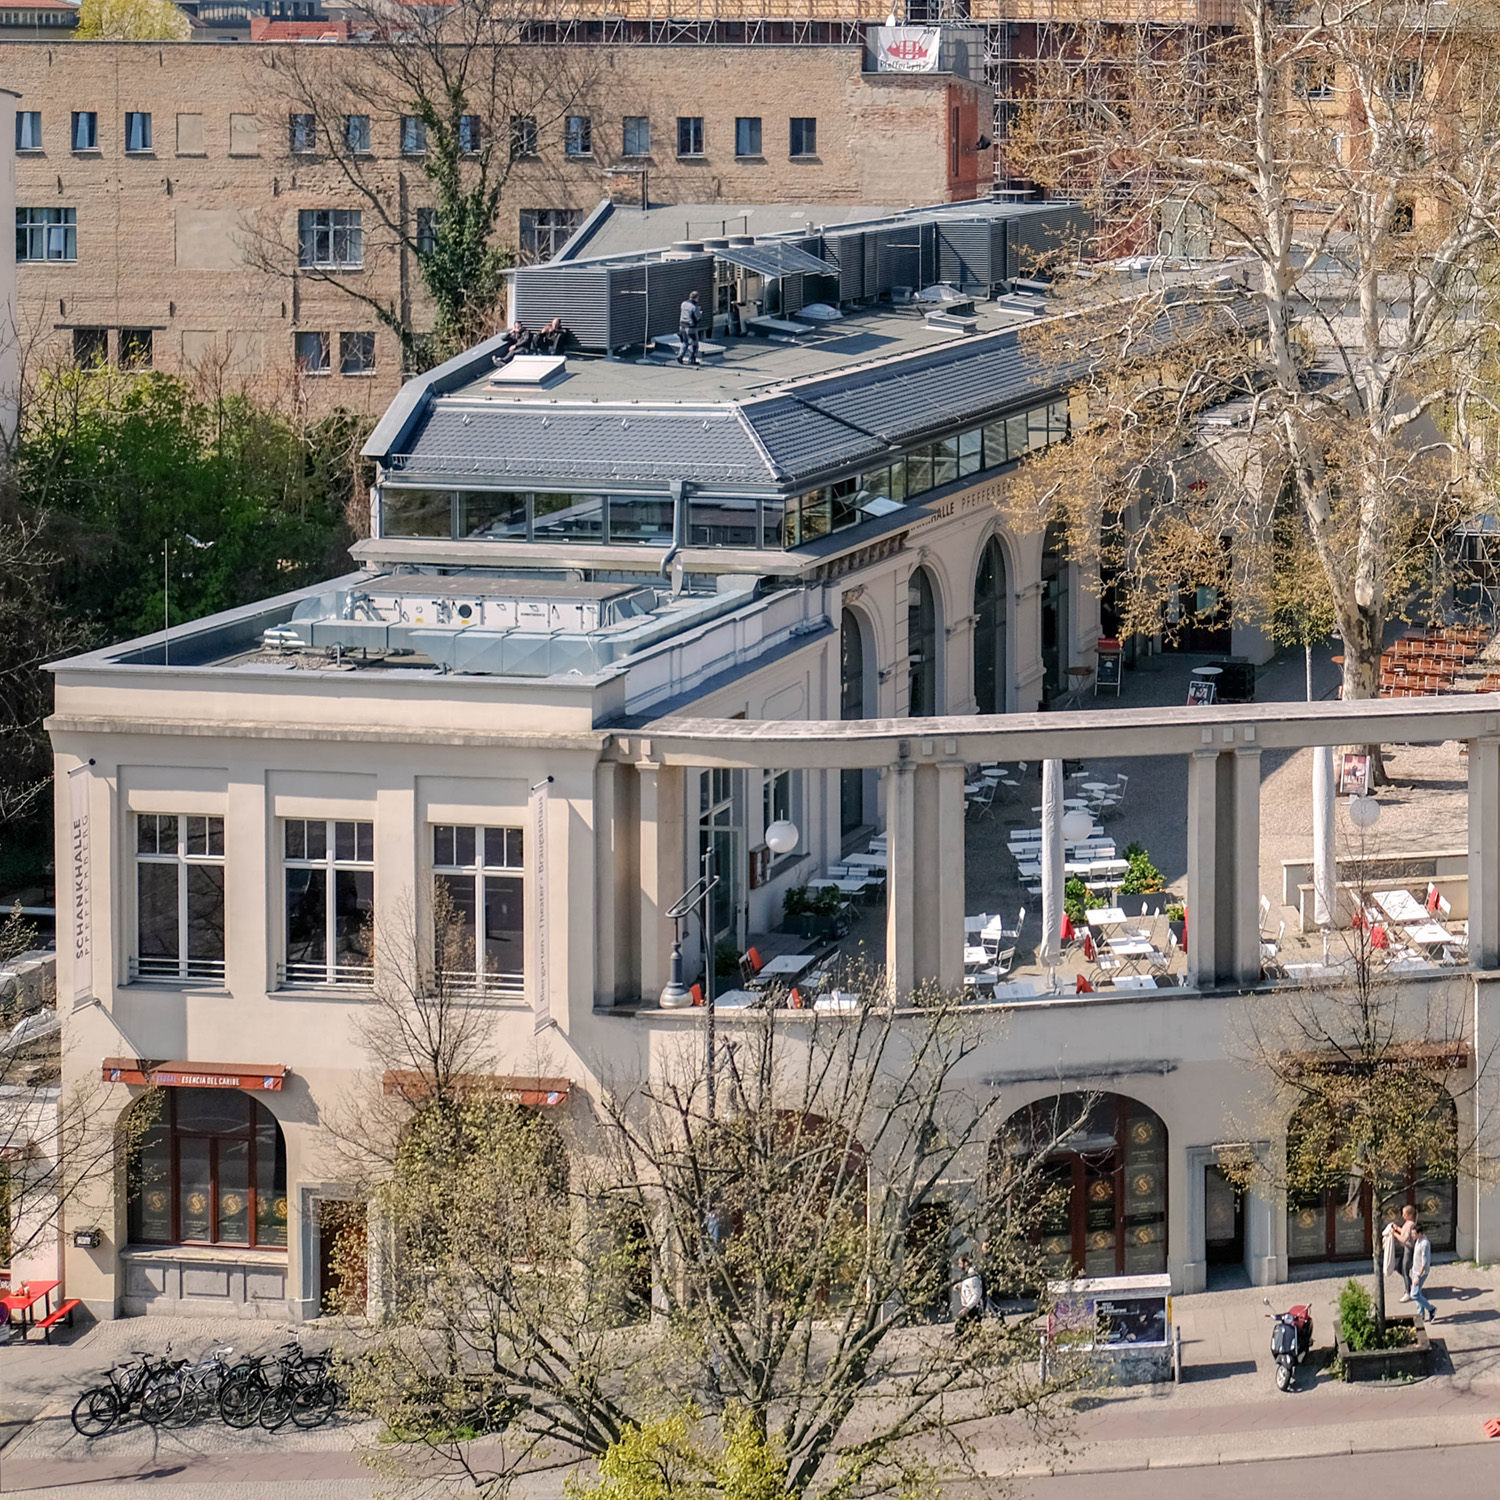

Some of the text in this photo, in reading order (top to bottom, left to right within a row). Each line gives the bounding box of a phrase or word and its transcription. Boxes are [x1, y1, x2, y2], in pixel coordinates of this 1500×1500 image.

[73, 818, 84, 960] SCHANKHALLE
[181, 1075, 206, 1085] ESENCIA
[206, 1076, 218, 1086] DEL
[218, 1077, 240, 1086] CARIBE
